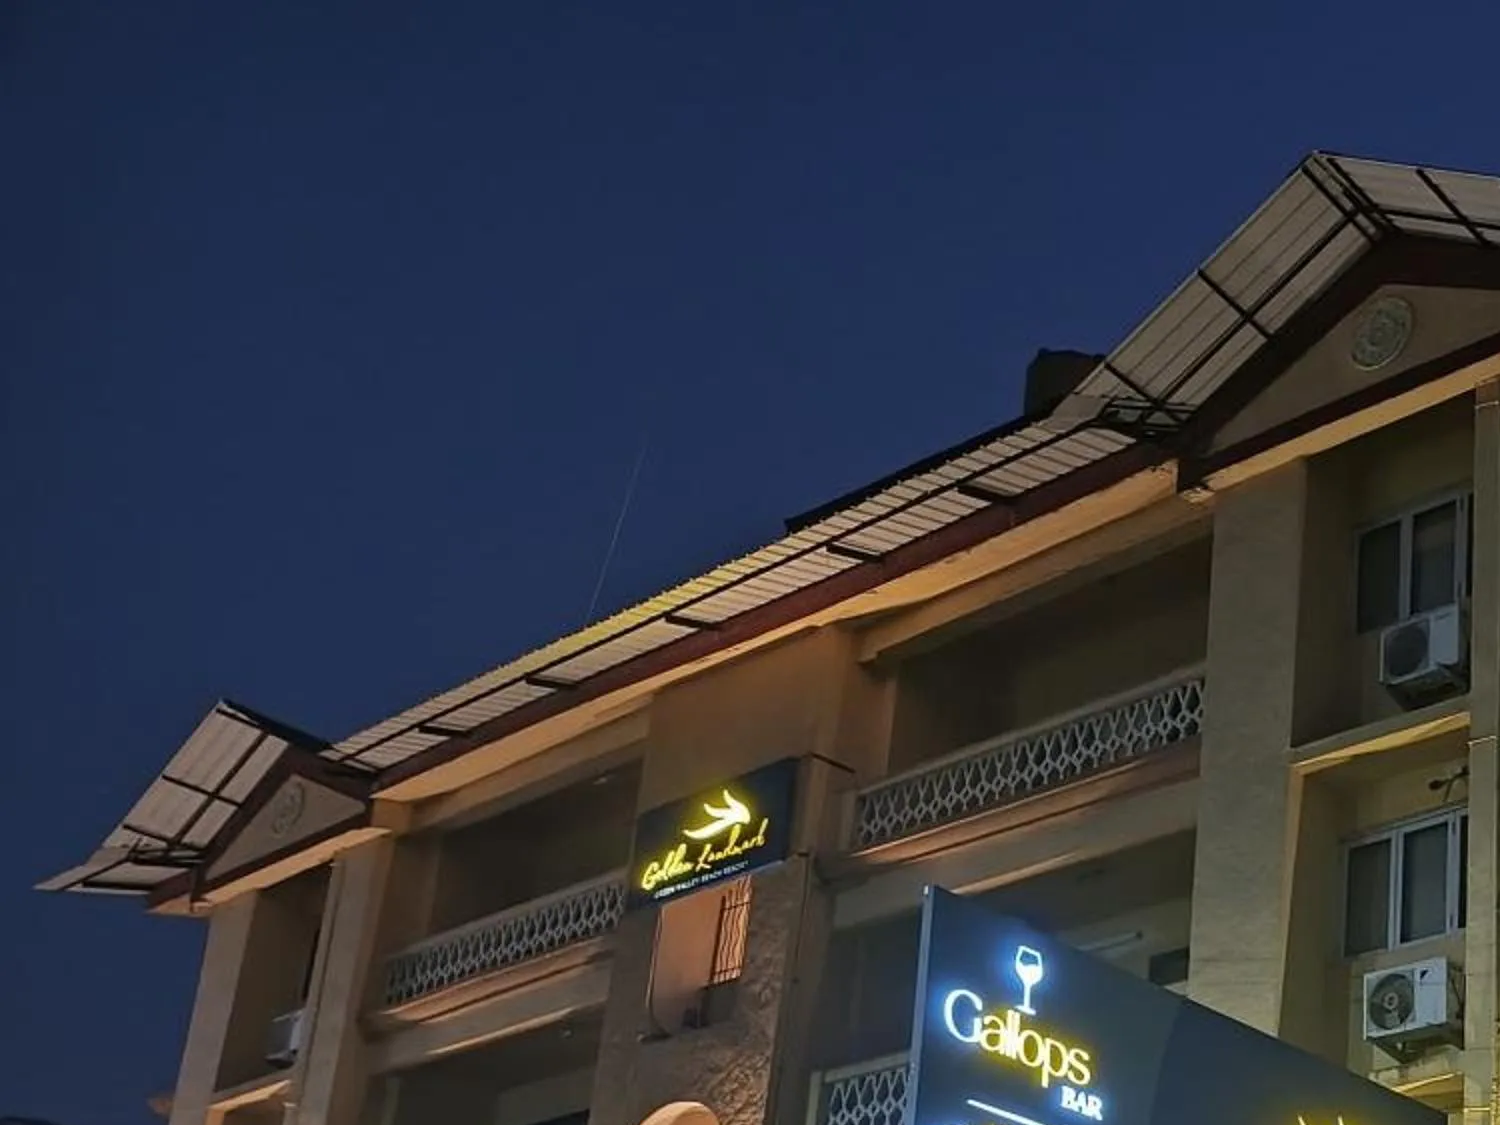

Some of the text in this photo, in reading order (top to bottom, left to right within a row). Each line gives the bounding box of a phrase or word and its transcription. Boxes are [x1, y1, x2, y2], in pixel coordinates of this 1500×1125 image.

[640, 818, 769, 890] Golden Landmark
[944, 989, 1091, 1088] Gallops
[1060, 1085, 1103, 1121] BAR
